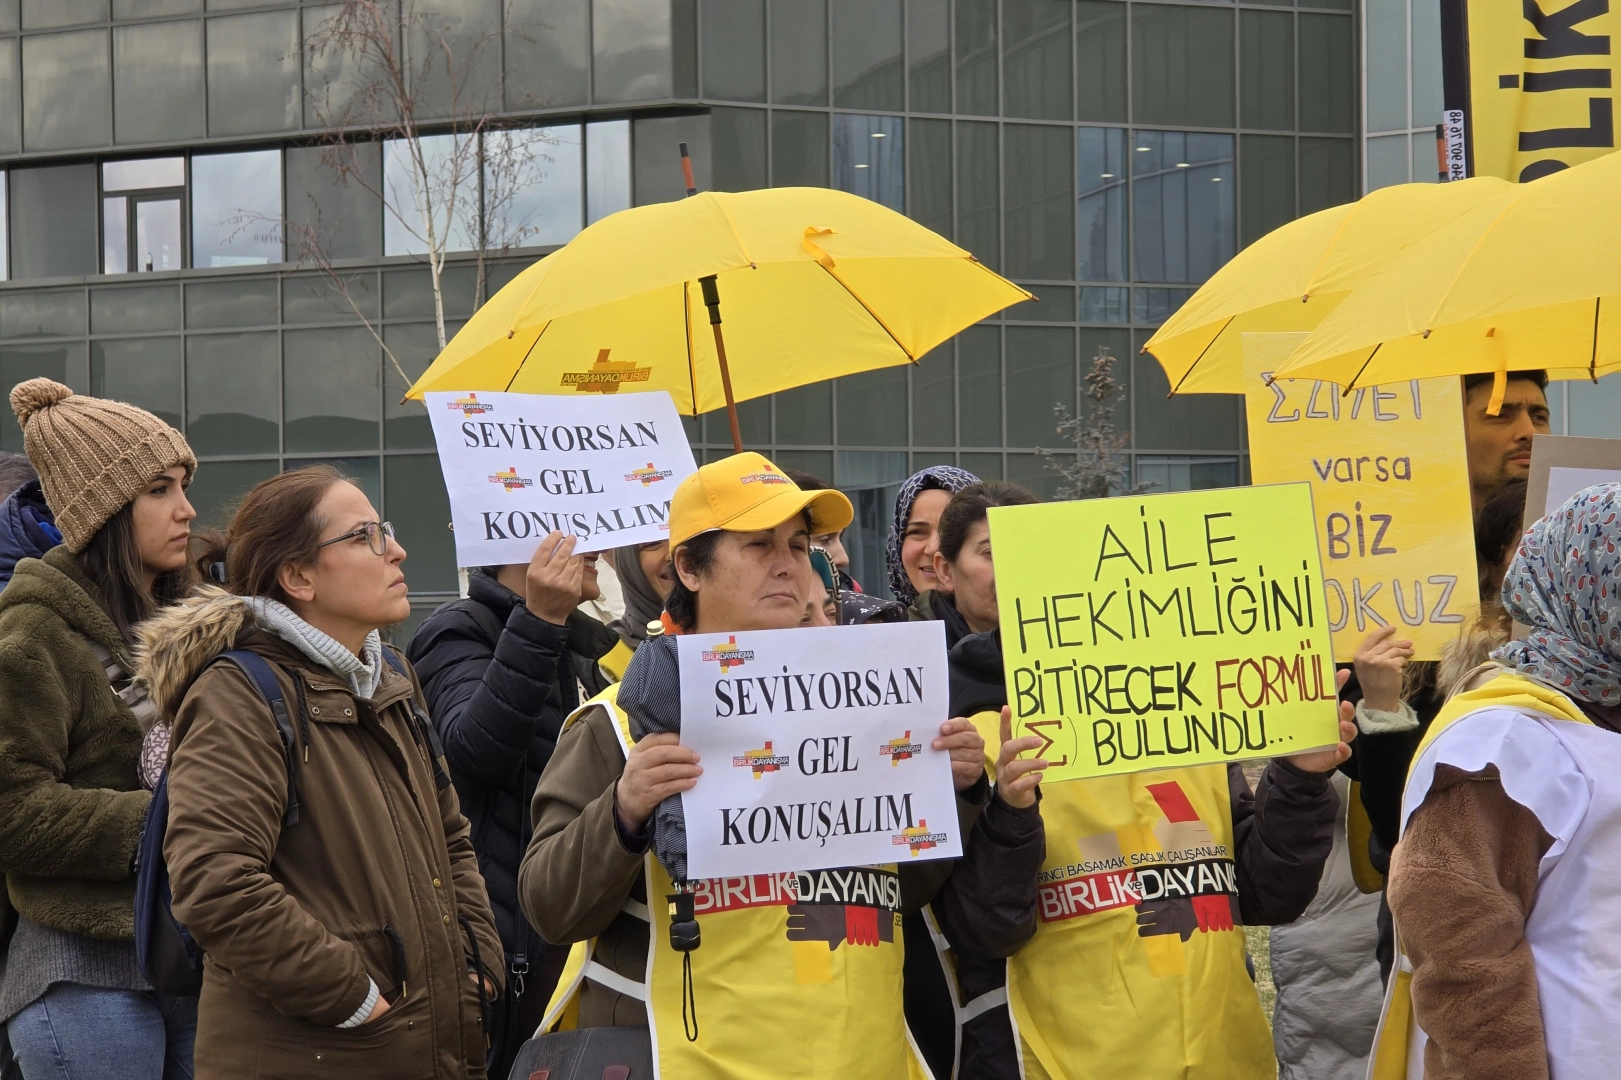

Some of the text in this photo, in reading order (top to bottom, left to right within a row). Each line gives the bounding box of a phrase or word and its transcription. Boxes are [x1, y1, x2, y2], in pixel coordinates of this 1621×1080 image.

[461, 417, 660, 452] SEVİYORSAN
[539, 469, 605, 495] GEL
[1312, 456, 1412, 483] varsa
[481, 500, 671, 541] KONUŞALIM
[1327, 500, 1397, 560] BİZ
[1094, 505, 1239, 581] AİLE
[1016, 560, 1314, 654] HEKİMLİĞİNİ
[715, 665, 924, 718] SEVİYORSAN
[1014, 639, 1337, 718] BİTİRECEK FORMÜL
[797, 735, 859, 776] GEL
[1092, 710, 1294, 766] BULUNDU...
[719, 793, 914, 847] KONUŞALIM
[787, 879, 799, 889] ve
[1066, 856, 1128, 877] BASAMAK
[1127, 881, 1143, 890] ve
